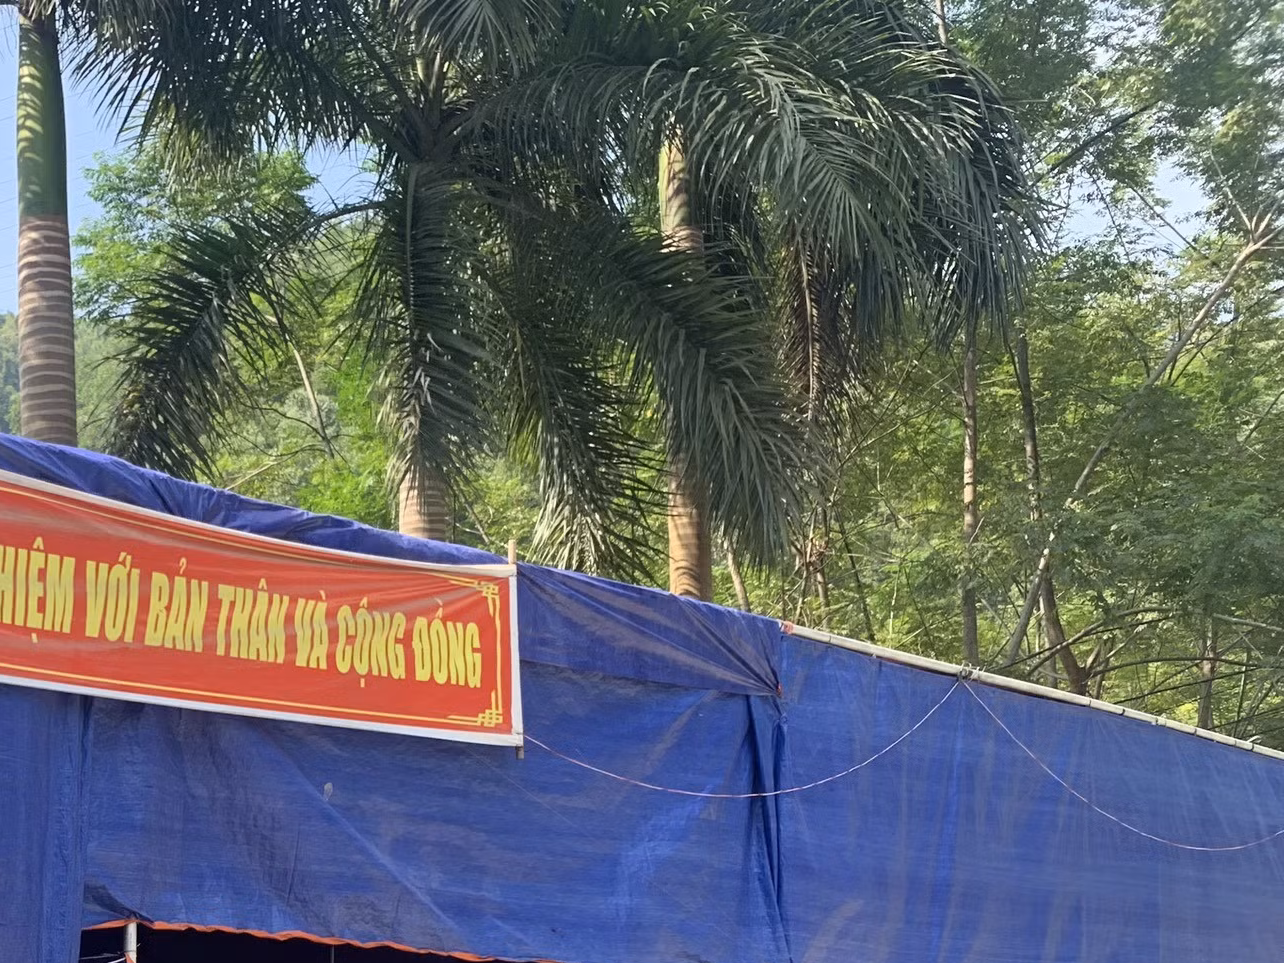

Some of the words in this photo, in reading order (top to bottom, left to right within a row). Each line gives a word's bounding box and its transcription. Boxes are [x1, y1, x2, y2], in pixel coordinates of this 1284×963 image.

[85, 552, 140, 643] VỚI
[144, 558, 209, 652] BẢN
[216, 579, 285, 664] THÂN
[295, 590, 328, 670] VÀ
[336, 597, 406, 688] CỘNG
[412, 597, 483, 689] ĐỒNG
